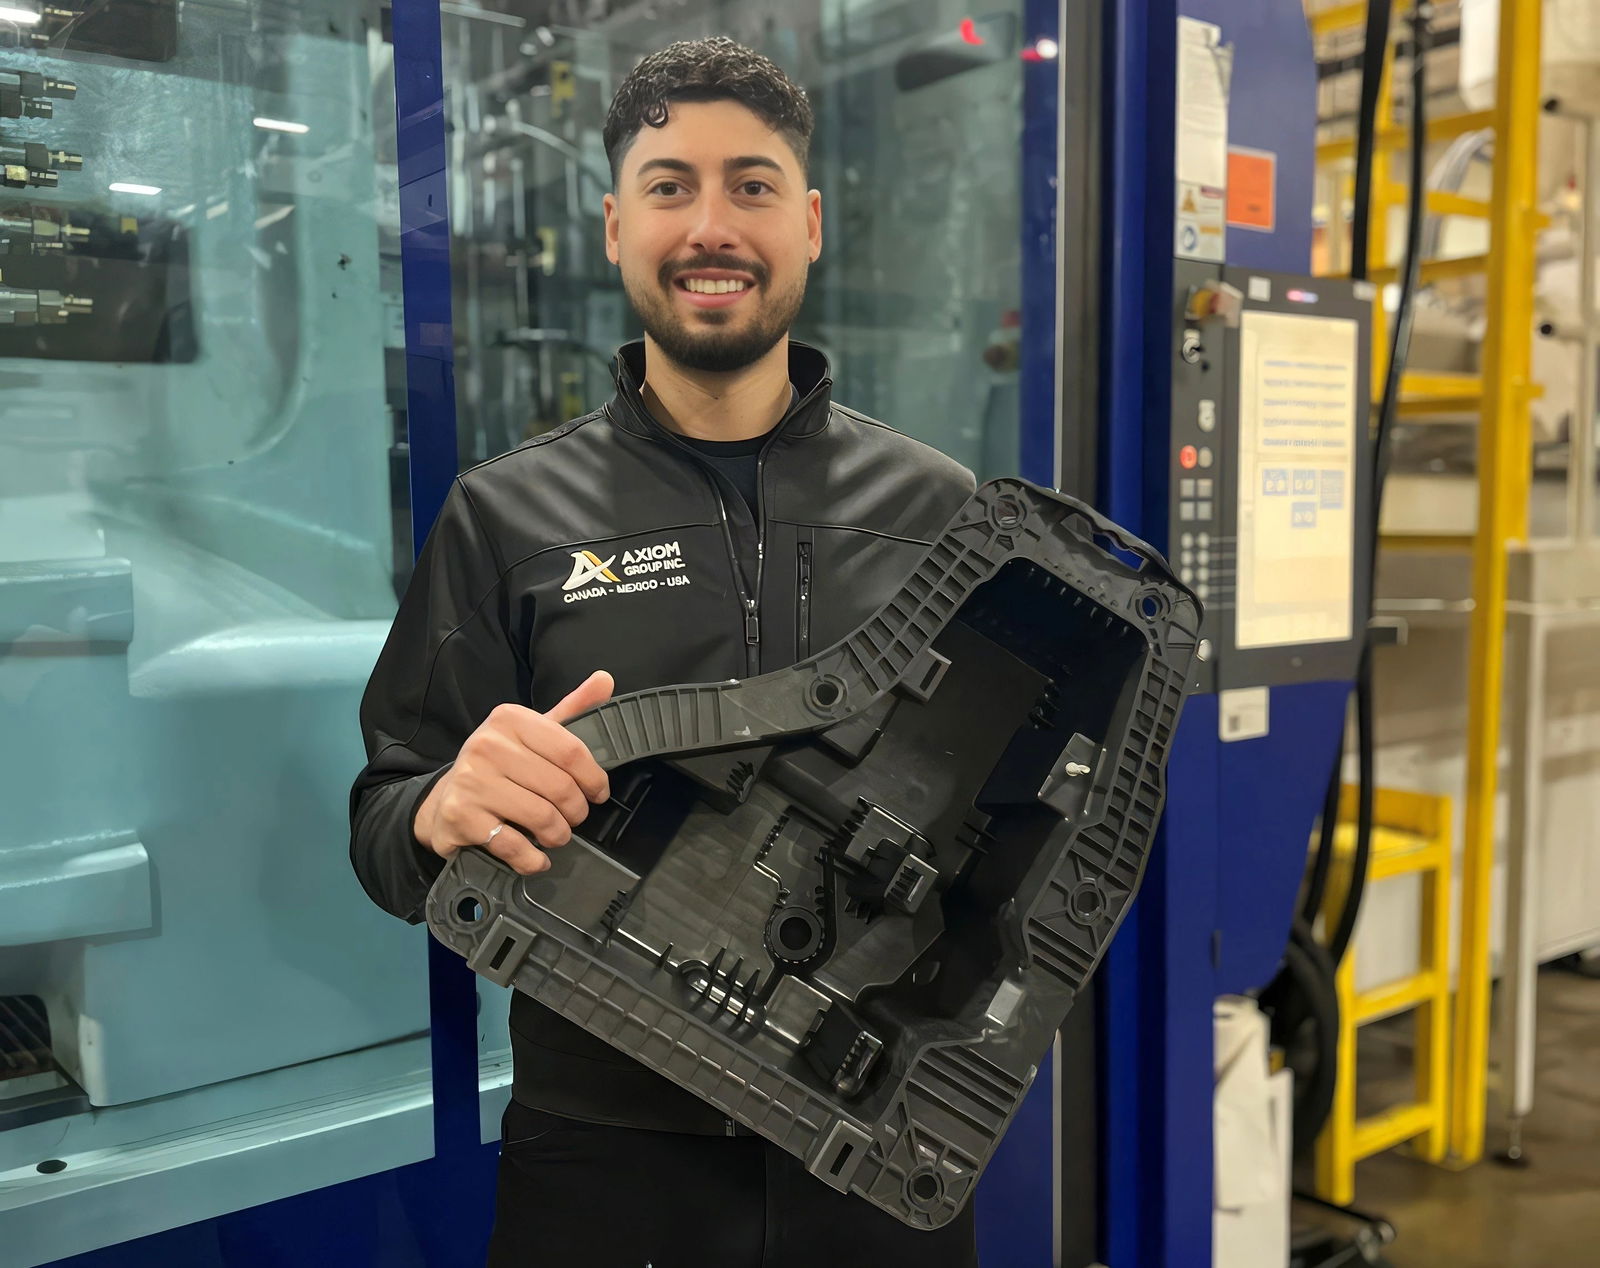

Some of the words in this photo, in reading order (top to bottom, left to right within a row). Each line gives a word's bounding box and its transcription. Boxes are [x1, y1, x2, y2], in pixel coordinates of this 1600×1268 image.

[621, 541, 681, 565] AXIOM
[623, 561, 663, 576] GROUP
[663, 558, 686, 569] INC.
[563, 586, 607, 603] CANADA
[616, 579, 658, 593] MEXICO
[666, 575, 690, 587] USA
